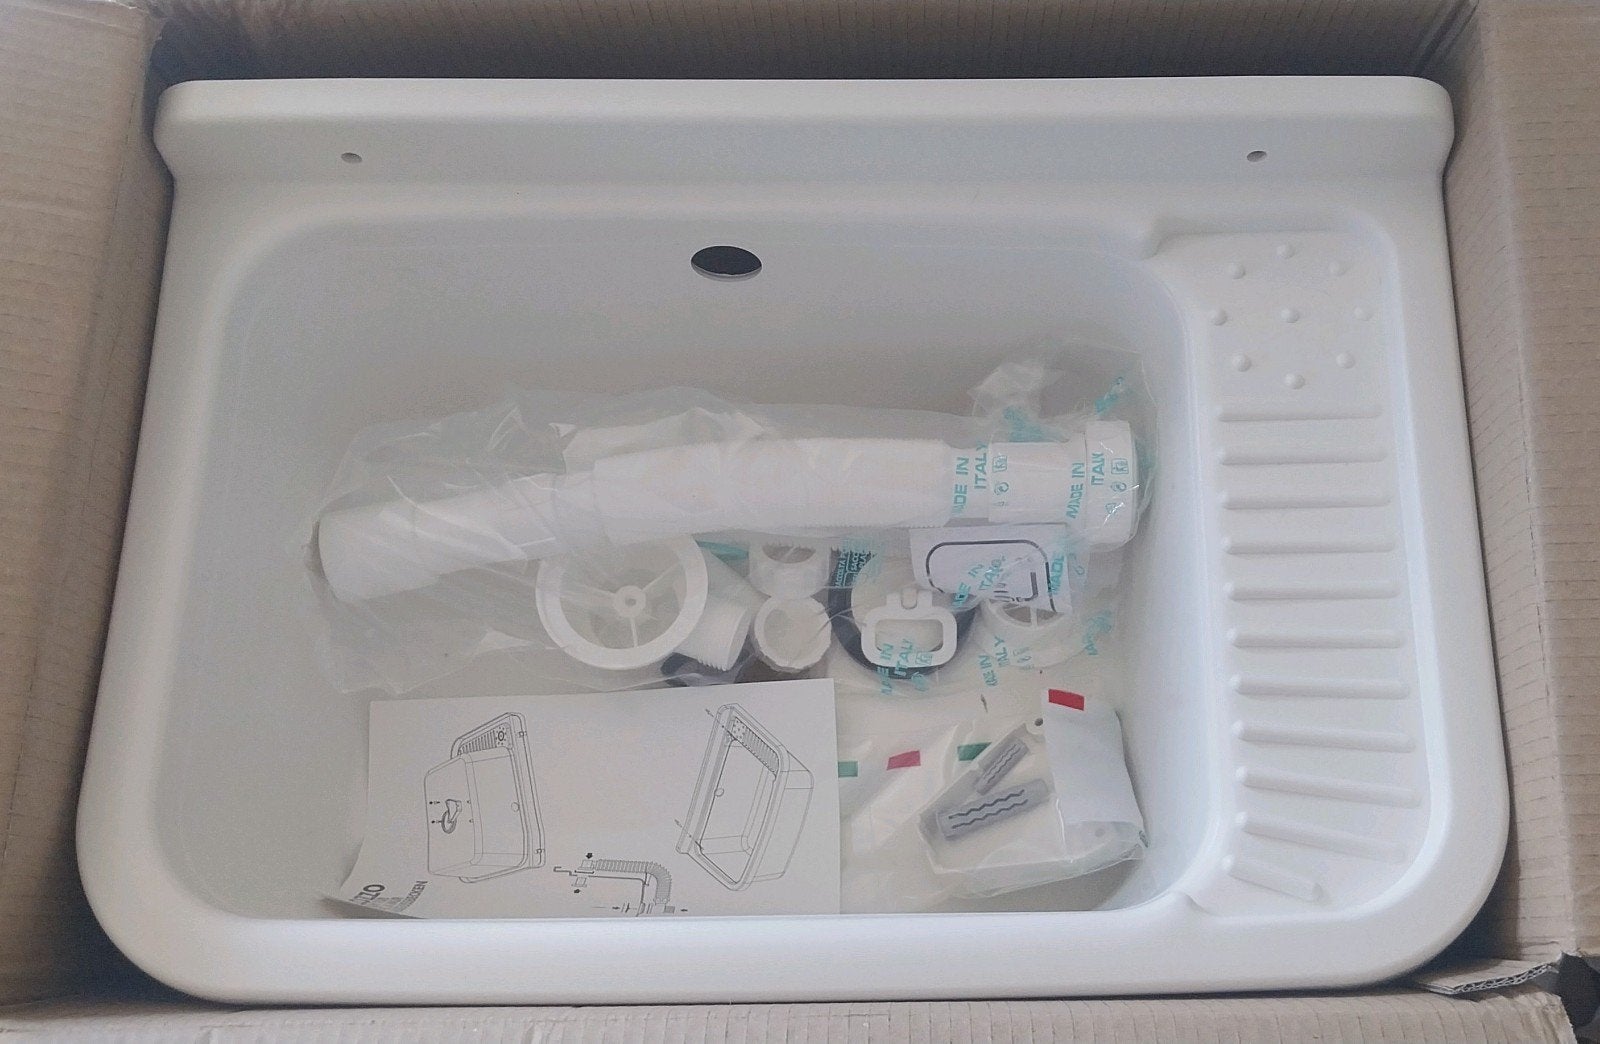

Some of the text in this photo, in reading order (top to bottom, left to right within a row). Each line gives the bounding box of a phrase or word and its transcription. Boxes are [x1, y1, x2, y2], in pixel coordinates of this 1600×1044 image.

[956, 457, 970, 476] IN
[974, 443, 989, 490] ITALY
[1065, 462, 1086, 519] MADE IN
[880, 643, 894, 661] IN
